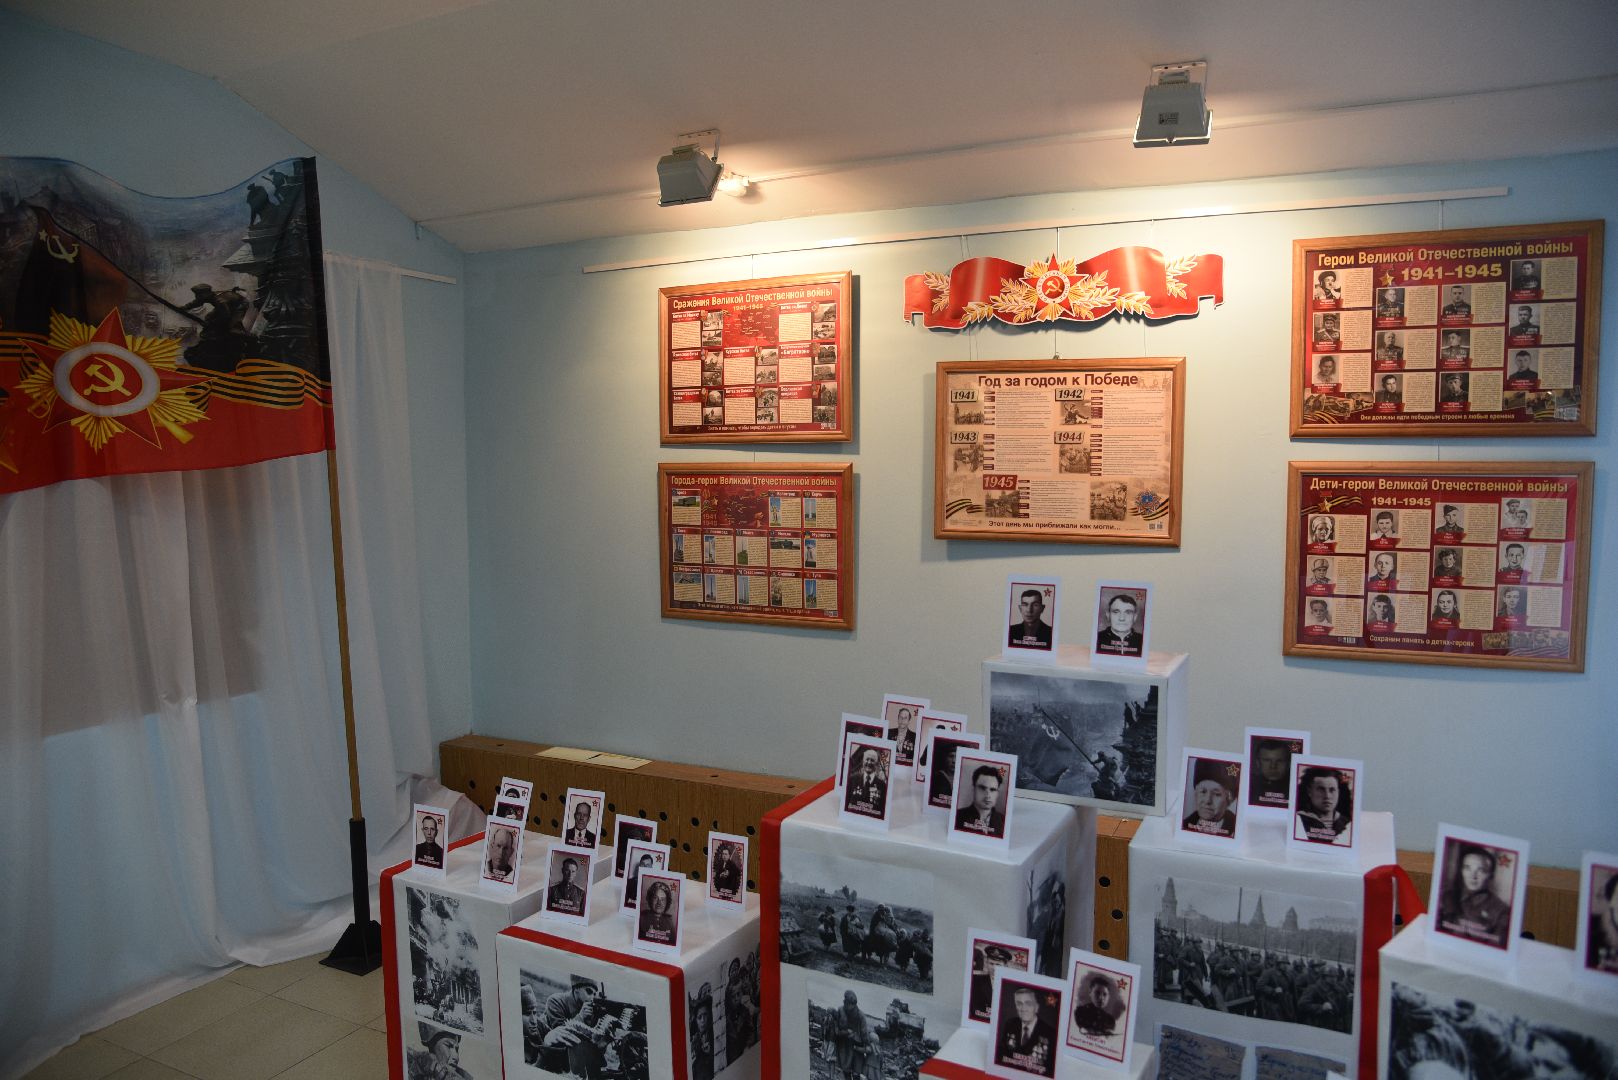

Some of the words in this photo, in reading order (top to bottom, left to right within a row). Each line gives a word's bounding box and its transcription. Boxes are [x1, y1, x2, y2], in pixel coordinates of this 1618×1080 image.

[1318, 253, 1354, 268] Герои
[1358, 249, 1414, 264] Великой
[1418, 241, 1522, 261] Отечественной
[1527, 240, 1573, 255] войны
[673, 299, 710, 310] Сражения
[711, 294, 744, 306] Великой
[745, 288, 805, 303] Отечественной
[806, 288, 833, 298] войны
[978, 376, 1001, 388] Год
[1005, 377, 1020, 386] за
[1024, 376, 1067, 388] годом
[1072, 377, 1080, 385] к
[1085, 373, 1139, 387] Победе
[954, 390, 976, 400] 1941
[1058, 389, 1083, 399] 1942
[952, 432, 977, 441] 1943
[1057, 432, 1082, 442] 1944
[672, 476, 718, 486] Города-герои
[720, 476, 751, 485] Великой
[752, 476, 810, 486] Отечественной
[811, 476, 837, 486] войны
[984, 476, 1014, 488] 1945
[1310, 477, 1375, 491] Дети-герои
[1379, 478, 1428, 490] Великой
[1431, 479, 1524, 492] Отечественной
[1527, 480, 1568, 492] войны
[1369, 634, 1401, 643] Сохраним
[1431, 639, 1475, 648] детях-героях
